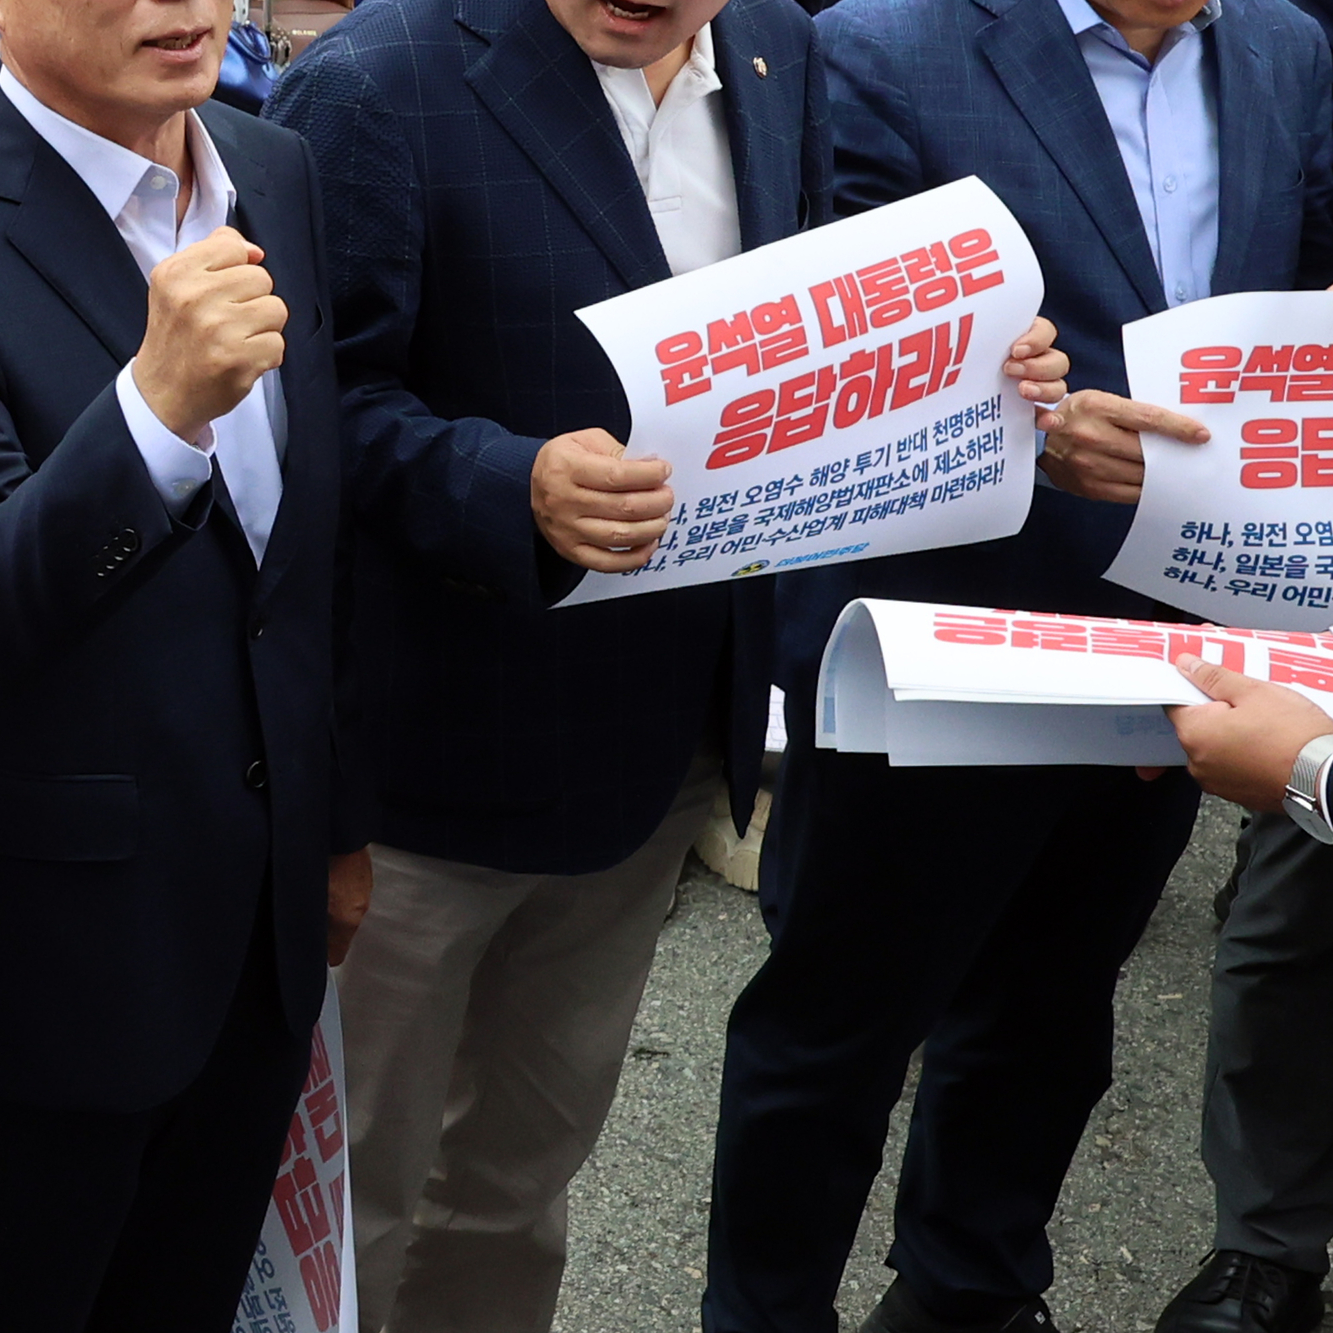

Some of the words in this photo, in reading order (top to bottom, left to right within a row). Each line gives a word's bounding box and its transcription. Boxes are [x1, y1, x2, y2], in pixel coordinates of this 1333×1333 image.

[654, 293, 810, 407] 윤석열
[808, 227, 1006, 350] 대통령은
[705, 312, 975, 471] 응답하라!
[685, 520, 749, 547] 일본을
[753, 461, 930, 528] 국제해양법재판소에
[932, 427, 1005, 478] 제소하라!
[695, 490, 740, 520] 원전
[744, 475, 804, 509] 오염수
[809, 461, 849, 489] 해양
[852, 445, 892, 476] 투기
[896, 434, 929, 465] 반대
[932, 393, 1003, 451] 천명하라!
[671, 541, 717, 567] 우리
[849, 488, 929, 526] 피해대책
[931, 460, 1006, 505] 마련하라!
[773, 542, 871, 567] 더불어민주당
[1171, 546, 1230, 574] 하나,
[1235, 554, 1309, 581] 일본을
[1180, 520, 1236, 547] 하나,
[1240, 521, 1289, 548] 원전
[1162, 566, 1220, 594] 하나,
[1223, 578, 1277, 604] 우리
